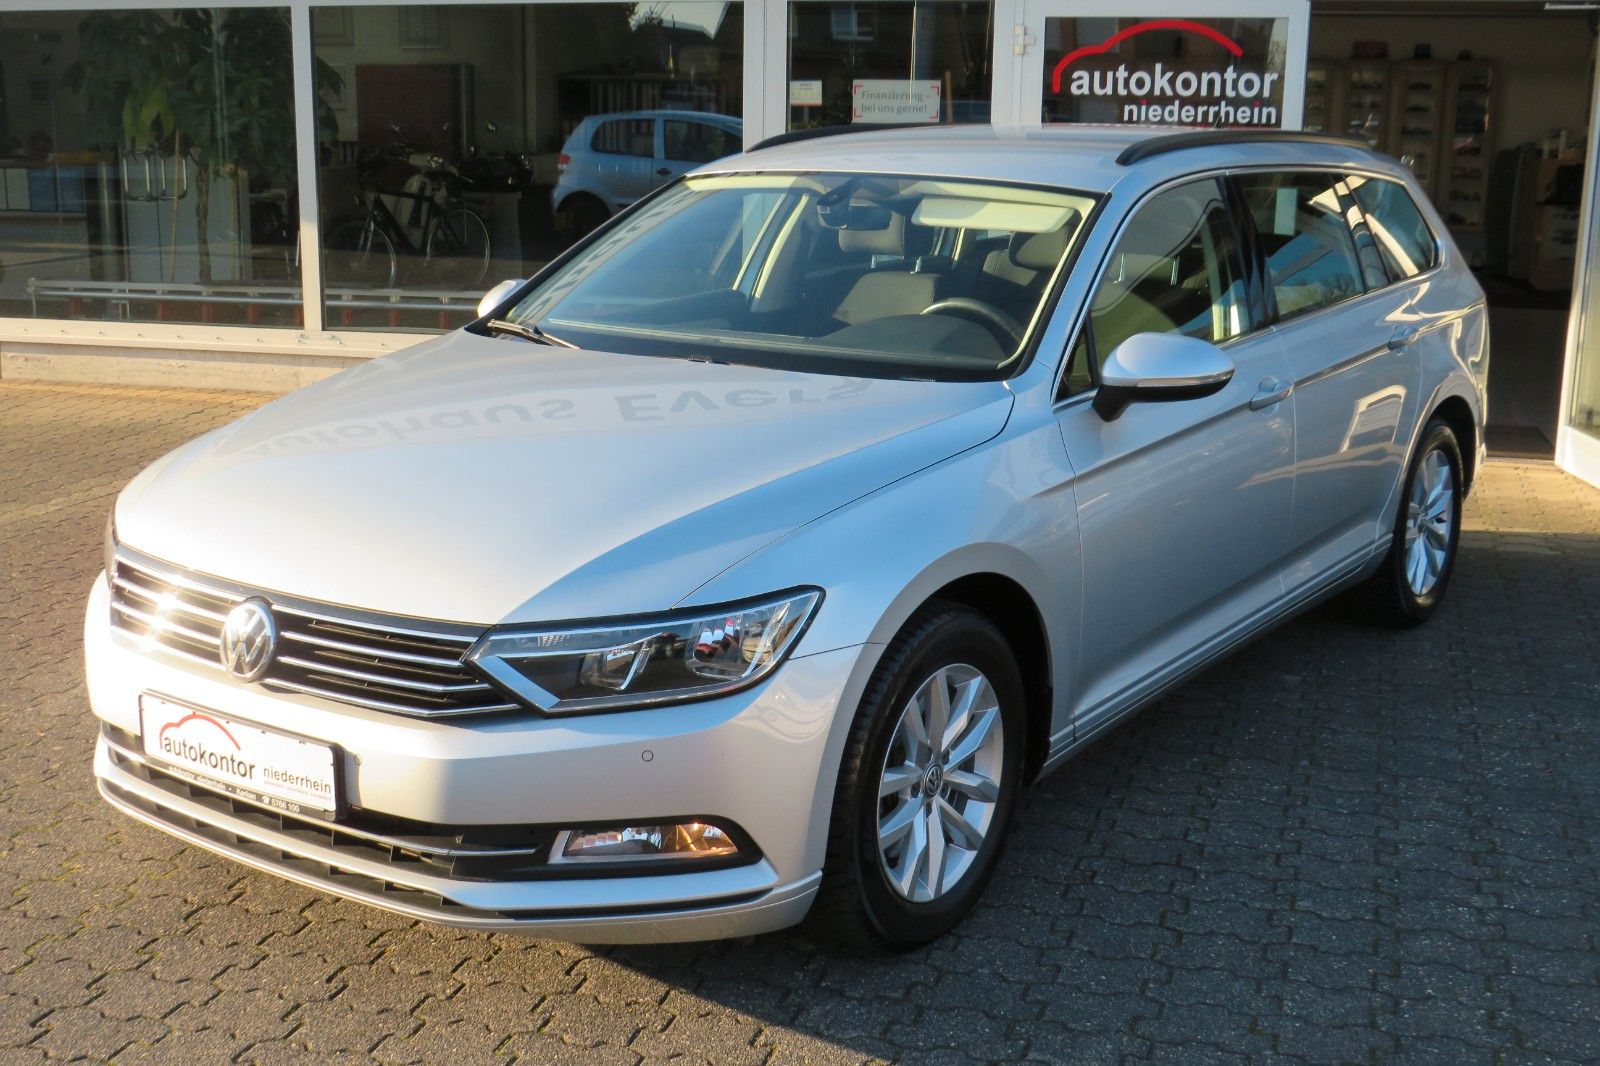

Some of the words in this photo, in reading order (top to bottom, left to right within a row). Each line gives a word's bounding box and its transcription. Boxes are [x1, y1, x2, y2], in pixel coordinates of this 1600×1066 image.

[1070, 63, 1278, 98] autokontor
[861, 104, 877, 113] bei
[896, 104, 927, 115] gerne!
[1123, 99, 1277, 125] niederrhein
[163, 734, 256, 780] autokontor
[263, 766, 332, 794] niederrhein
